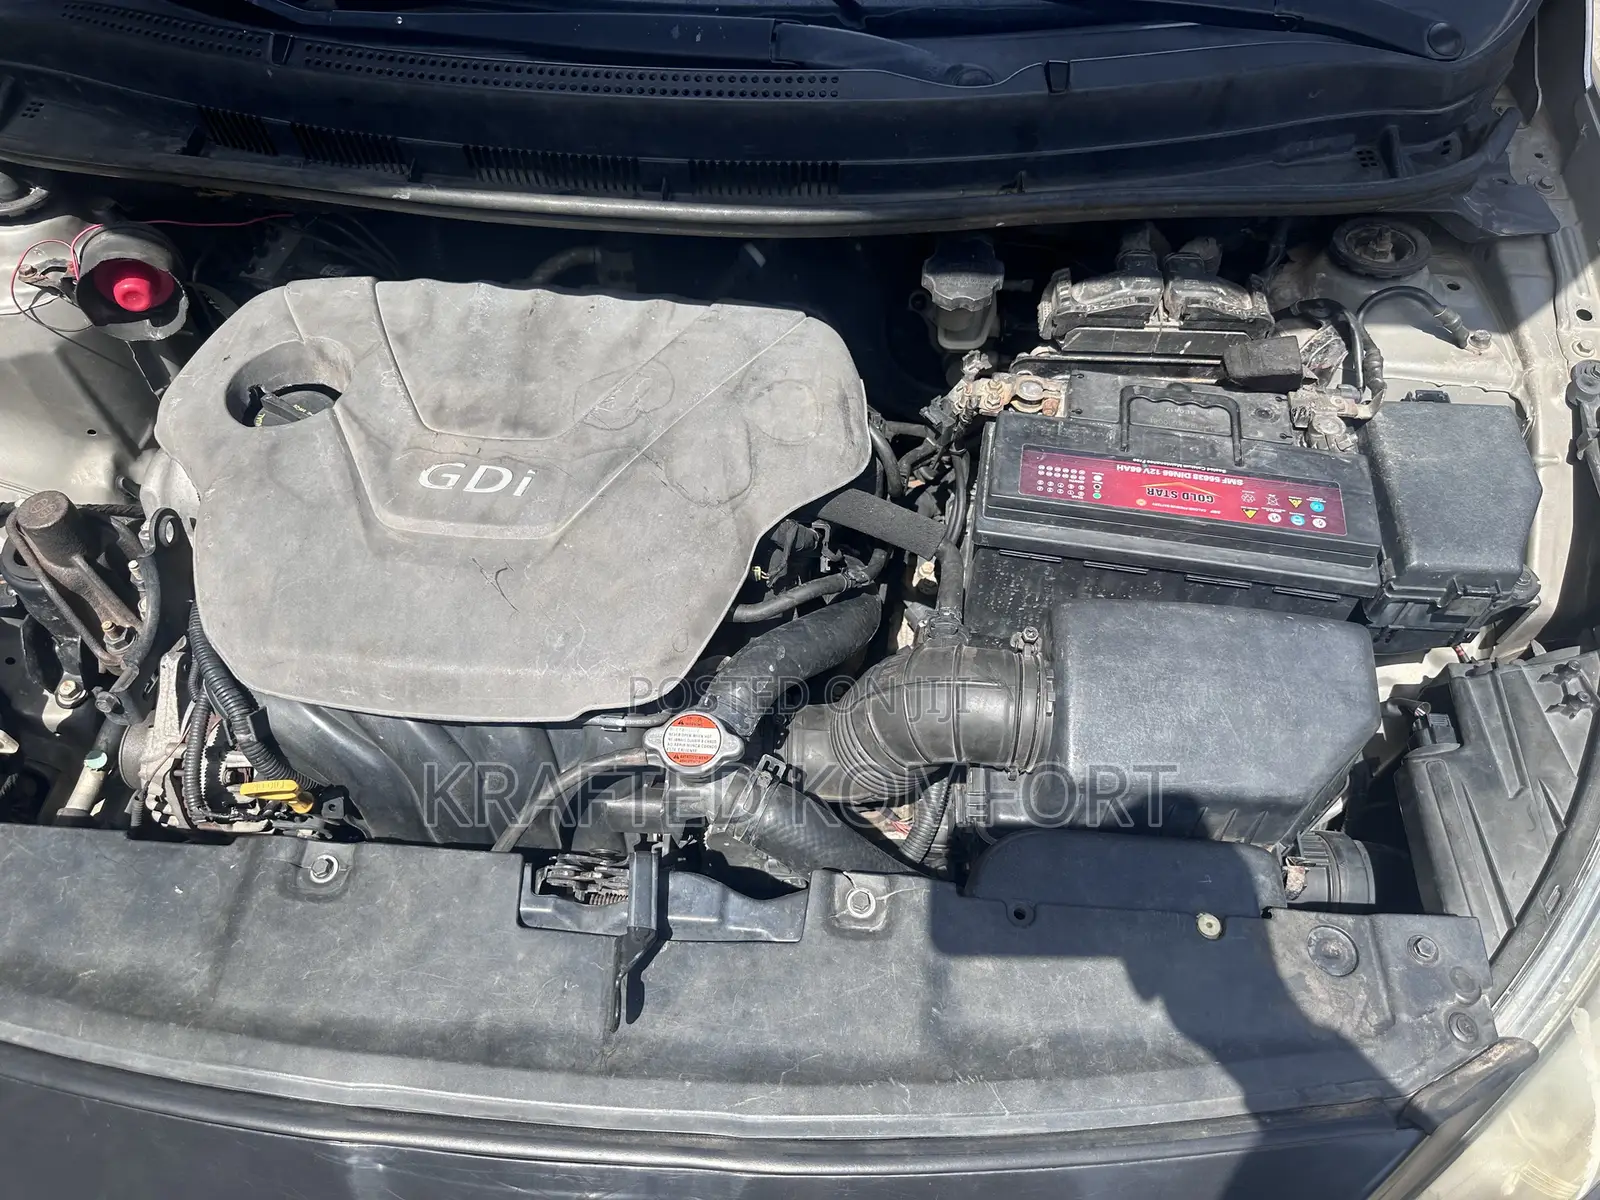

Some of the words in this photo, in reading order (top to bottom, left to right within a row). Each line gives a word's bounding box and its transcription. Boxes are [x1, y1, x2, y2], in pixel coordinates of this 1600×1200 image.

[418, 462, 537, 497] GDi
[1222, 478, 1244, 486] SMF
[1147, 487, 1178, 498] STAR
[1182, 492, 1214, 504] GOLD
